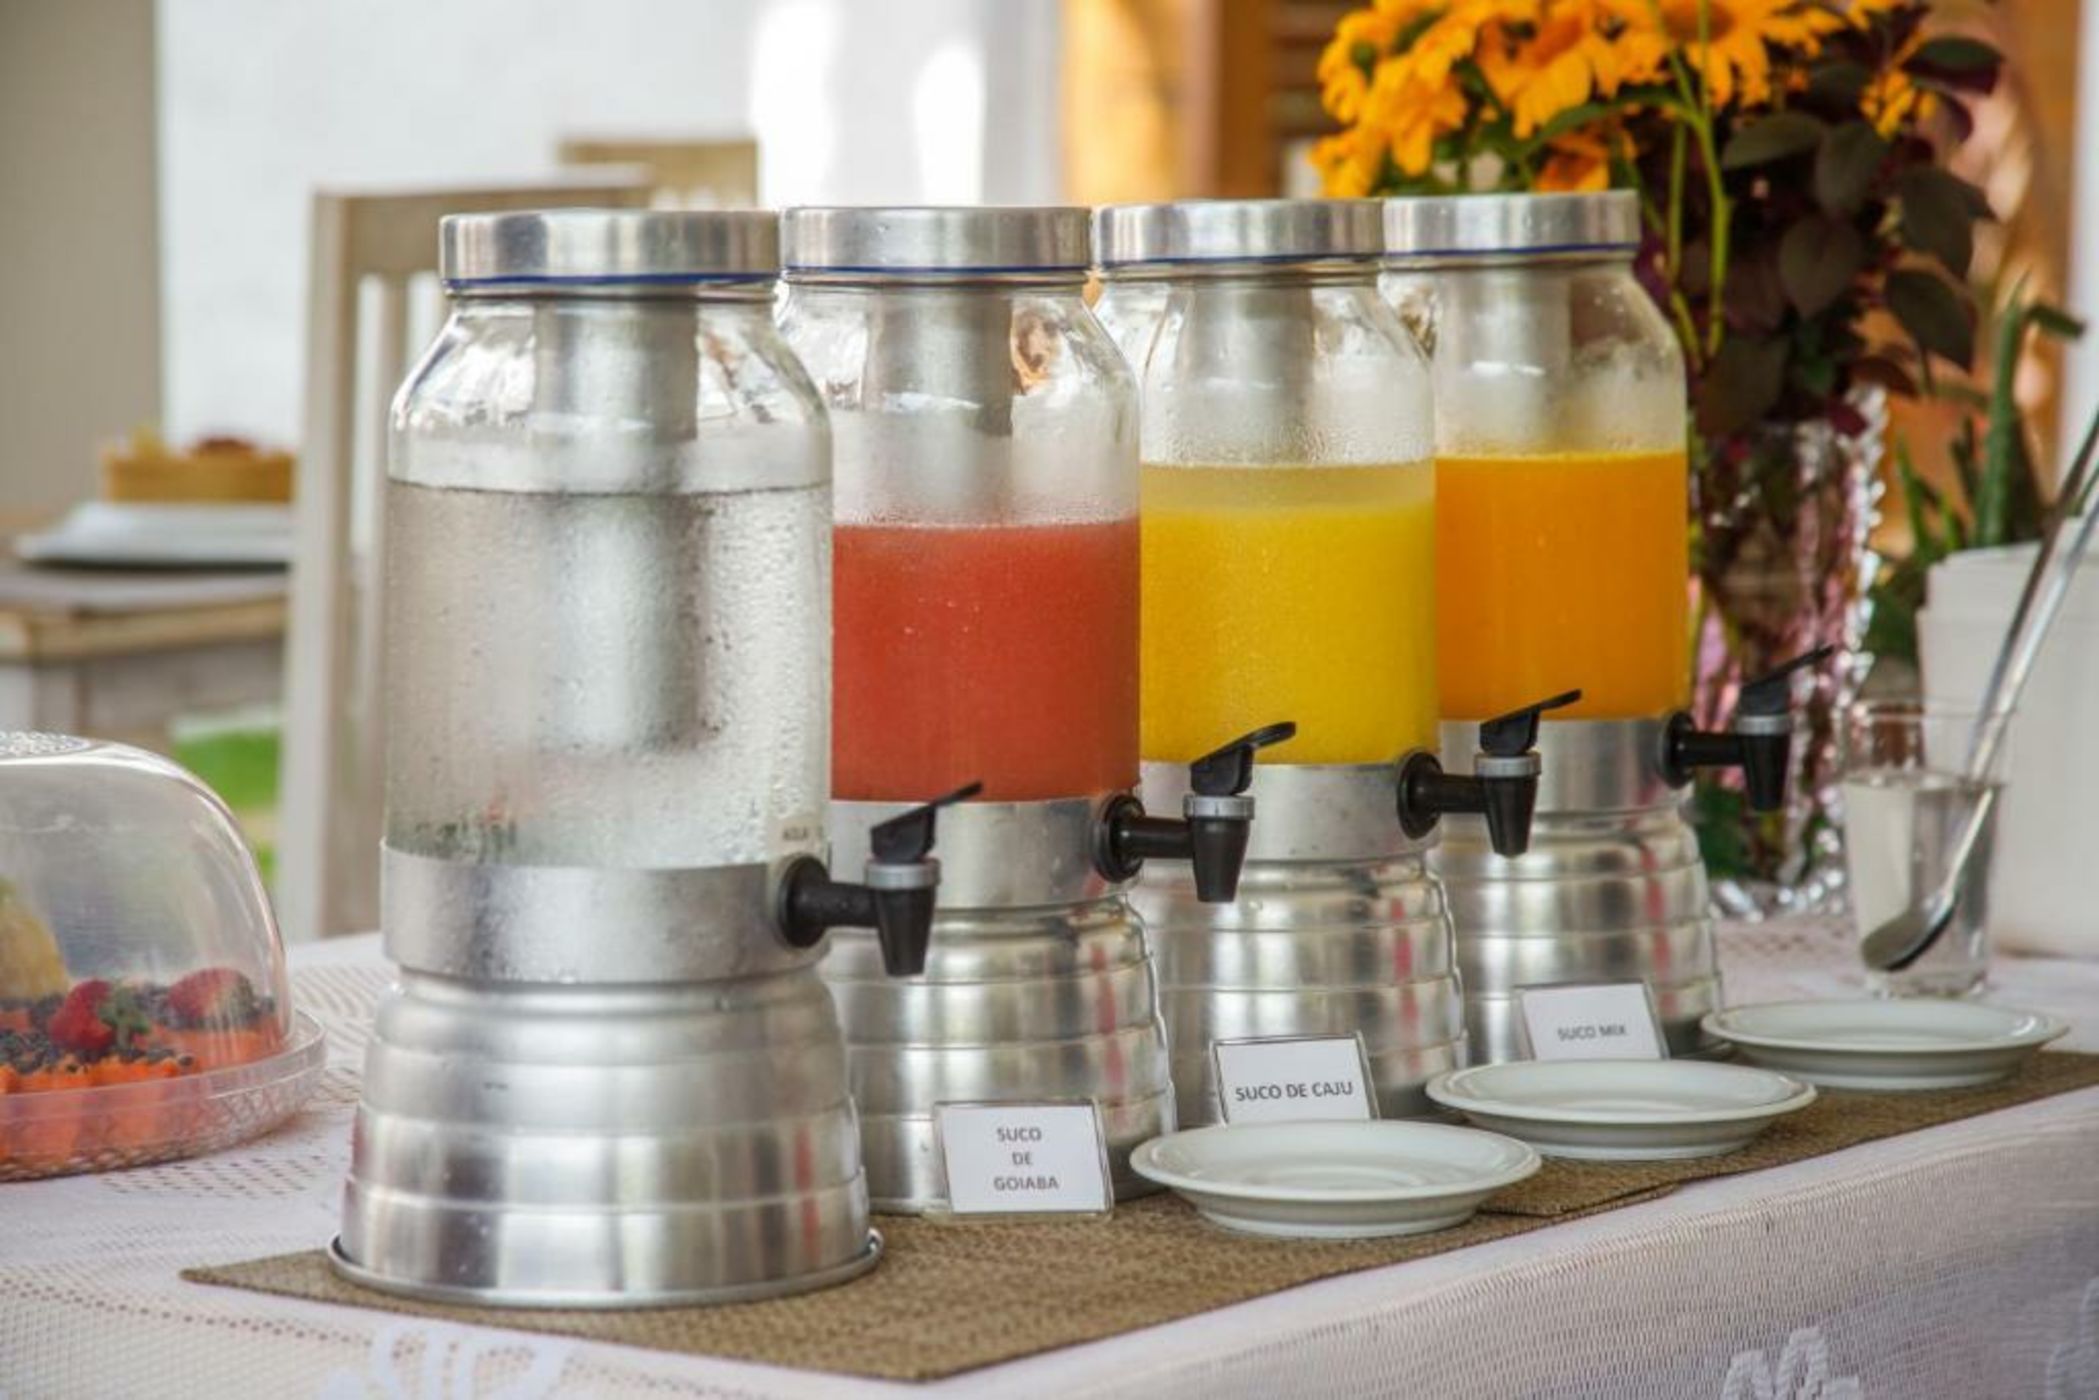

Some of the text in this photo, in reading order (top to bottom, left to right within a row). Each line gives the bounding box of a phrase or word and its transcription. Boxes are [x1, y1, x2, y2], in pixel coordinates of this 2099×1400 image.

[1557, 1024, 1627, 1042] SUCO MIX
[1236, 1081, 1353, 1102] SUCO DE CAJU
[997, 1127, 1043, 1142] SUCO
[1012, 1152, 1034, 1166] DE
[993, 1177, 1060, 1192] GOIABA
